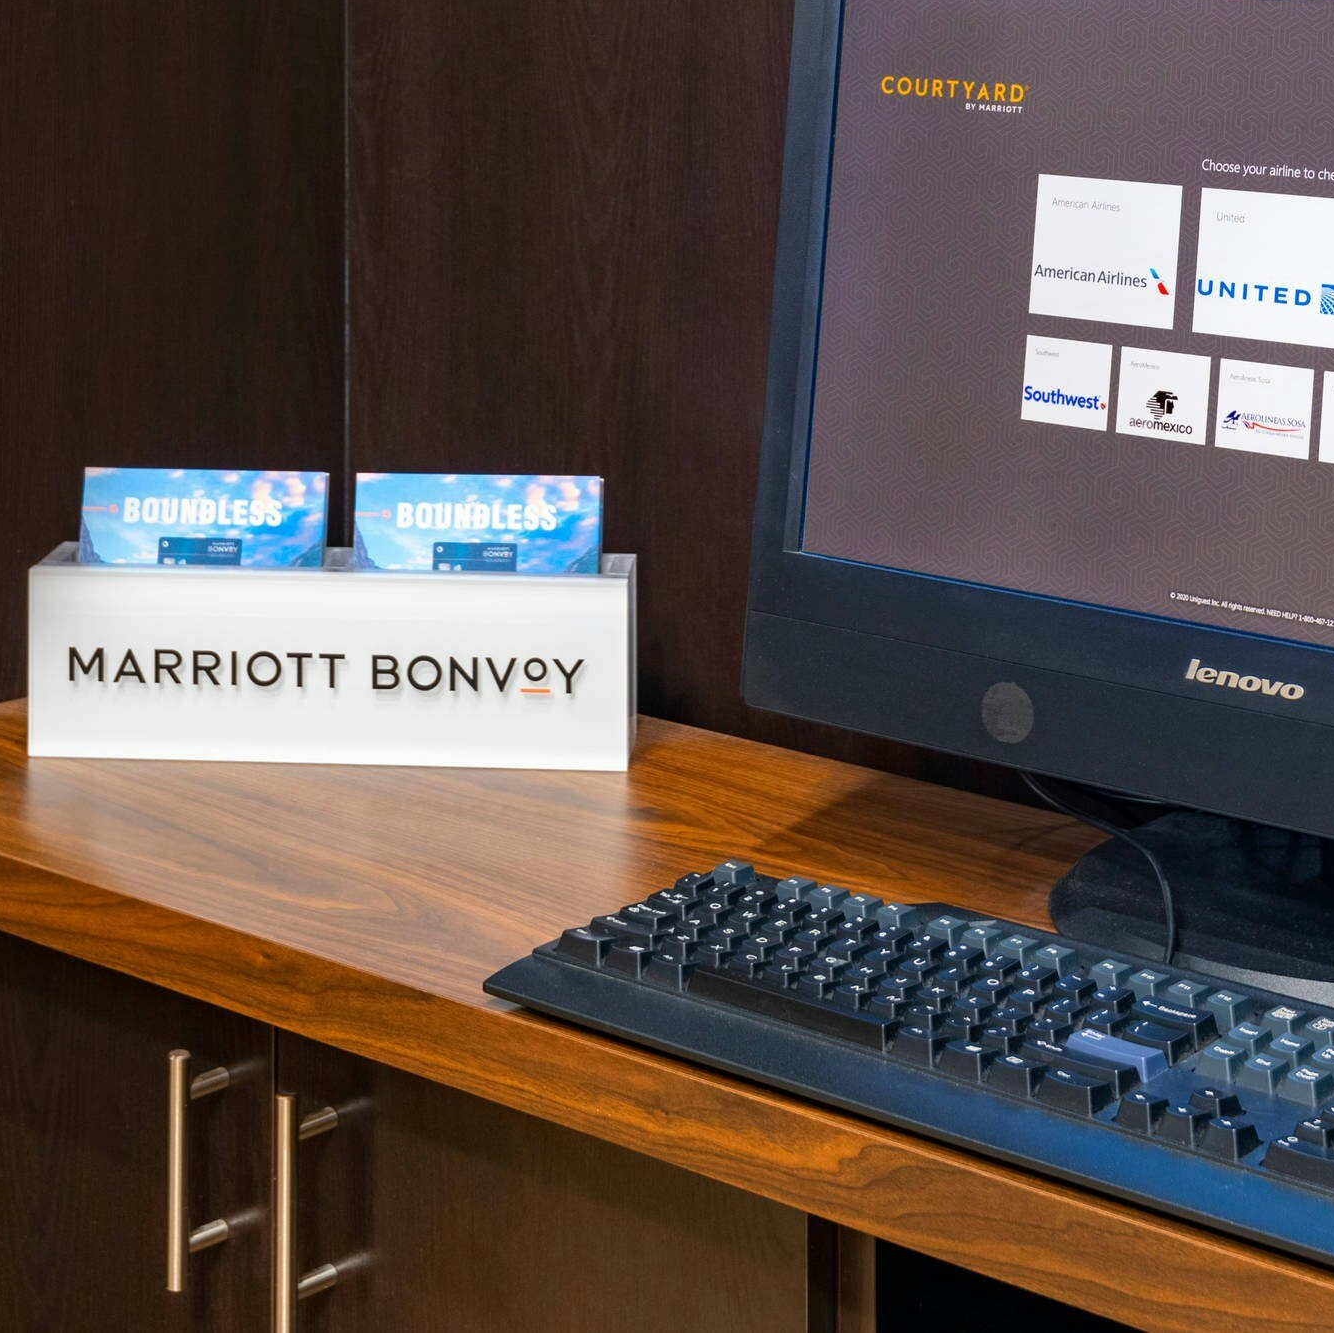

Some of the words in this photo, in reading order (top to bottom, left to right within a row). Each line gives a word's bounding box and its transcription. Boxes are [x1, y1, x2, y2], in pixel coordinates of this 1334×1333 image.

[880, 75, 1025, 103] COURTYARD
[965, 103, 977, 111] BY
[978, 103, 1024, 114] MARRIOTT
[1201, 159, 1241, 173] Choose
[1243, 165, 1267, 177] your
[1269, 165, 1301, 178] airline
[1304, 167, 1315, 179] to
[1052, 197, 1089, 209] American
[1091, 201, 1121, 212] Airlines
[1216, 211, 1246, 223] United
[1034, 264, 1096, 283] American
[1097, 270, 1147, 288] Airlines
[1197, 279, 1311, 306] UNITED
[1024, 385, 1099, 411] Southwest
[1129, 417, 1193, 435] aeromexico
[123, 496, 283, 527] BOUNDLESS
[396, 502, 558, 532] BOUNDLESS
[1228, 602, 1242, 612] rights
[68, 646, 346, 689] MARRIOTT
[372, 654, 585, 695] BONVOY
[1185, 658, 1305, 700] lenovo
